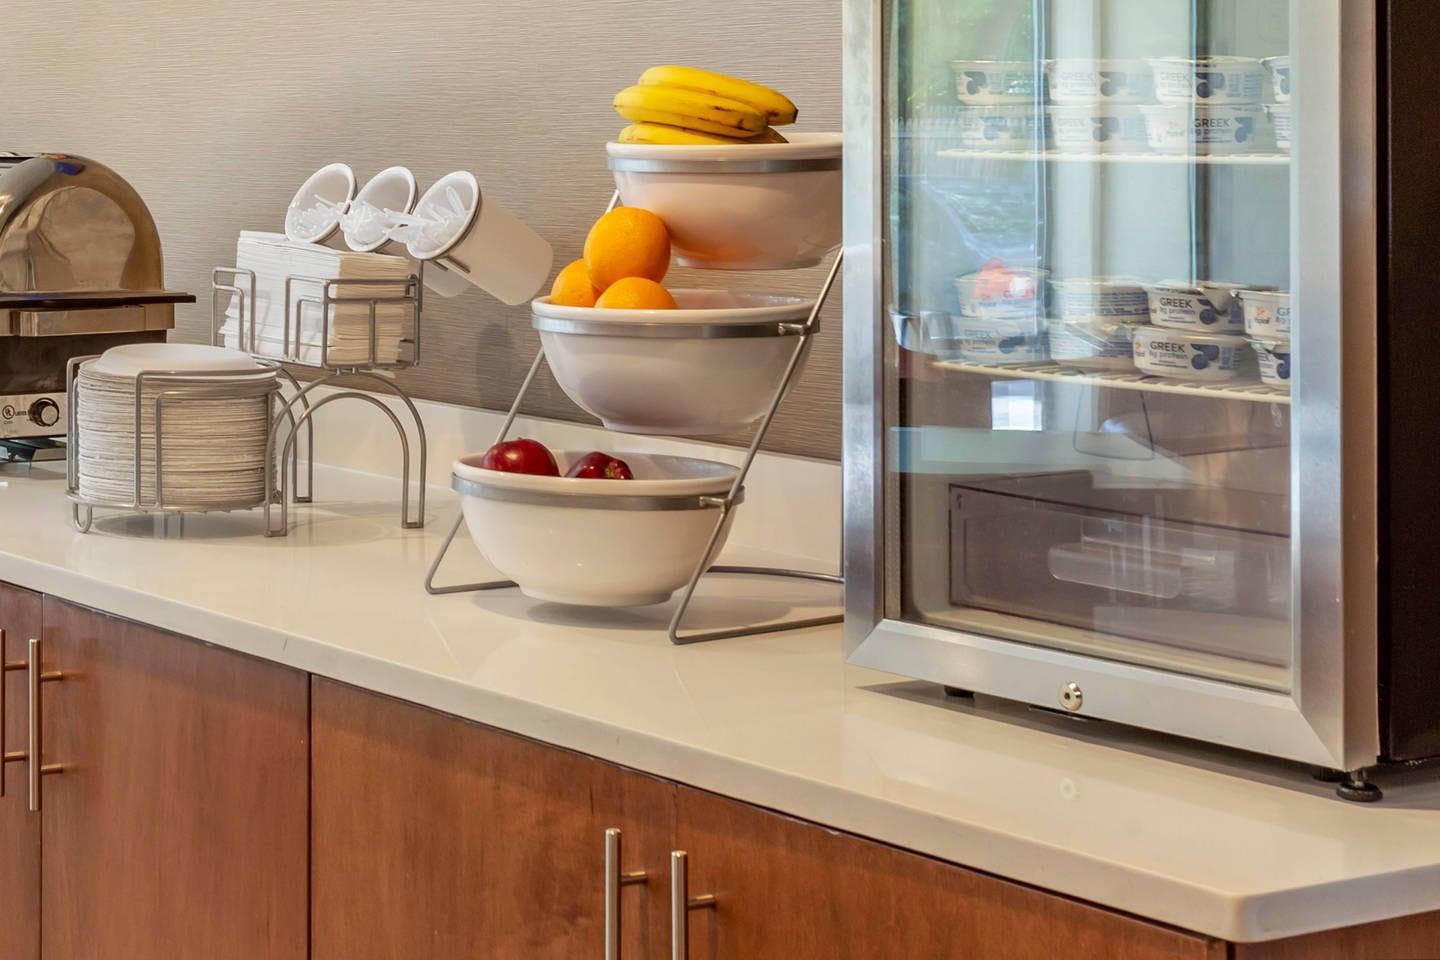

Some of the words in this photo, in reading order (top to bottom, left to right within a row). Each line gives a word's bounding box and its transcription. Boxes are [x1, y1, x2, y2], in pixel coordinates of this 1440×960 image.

[1193, 118, 1231, 128] GREEK
[1159, 296, 1193, 308] GREEK
[1150, 341, 1185, 353] GREEK
